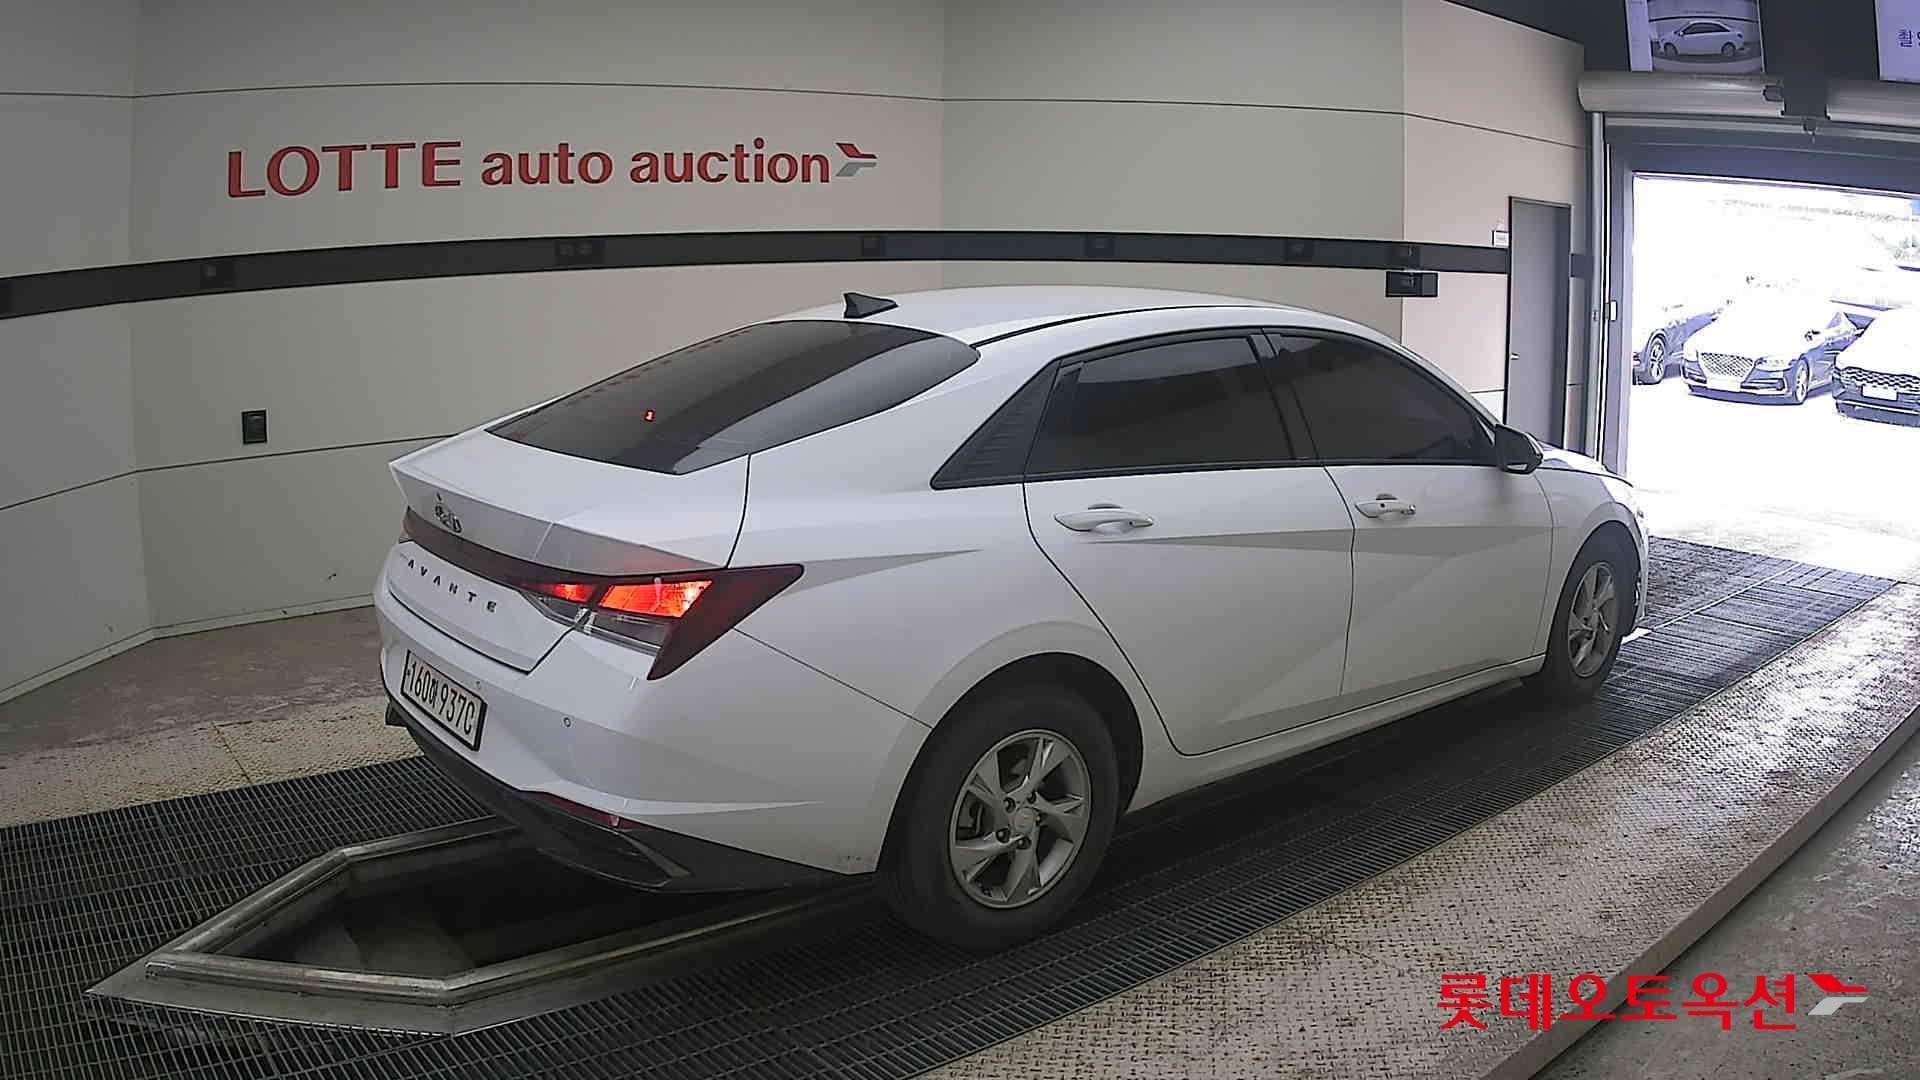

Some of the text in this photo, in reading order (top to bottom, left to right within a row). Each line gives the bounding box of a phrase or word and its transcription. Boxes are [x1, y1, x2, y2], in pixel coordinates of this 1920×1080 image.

[228, 138, 831, 197] LOTTE auto auction
[407, 559, 497, 613] AVANTE
